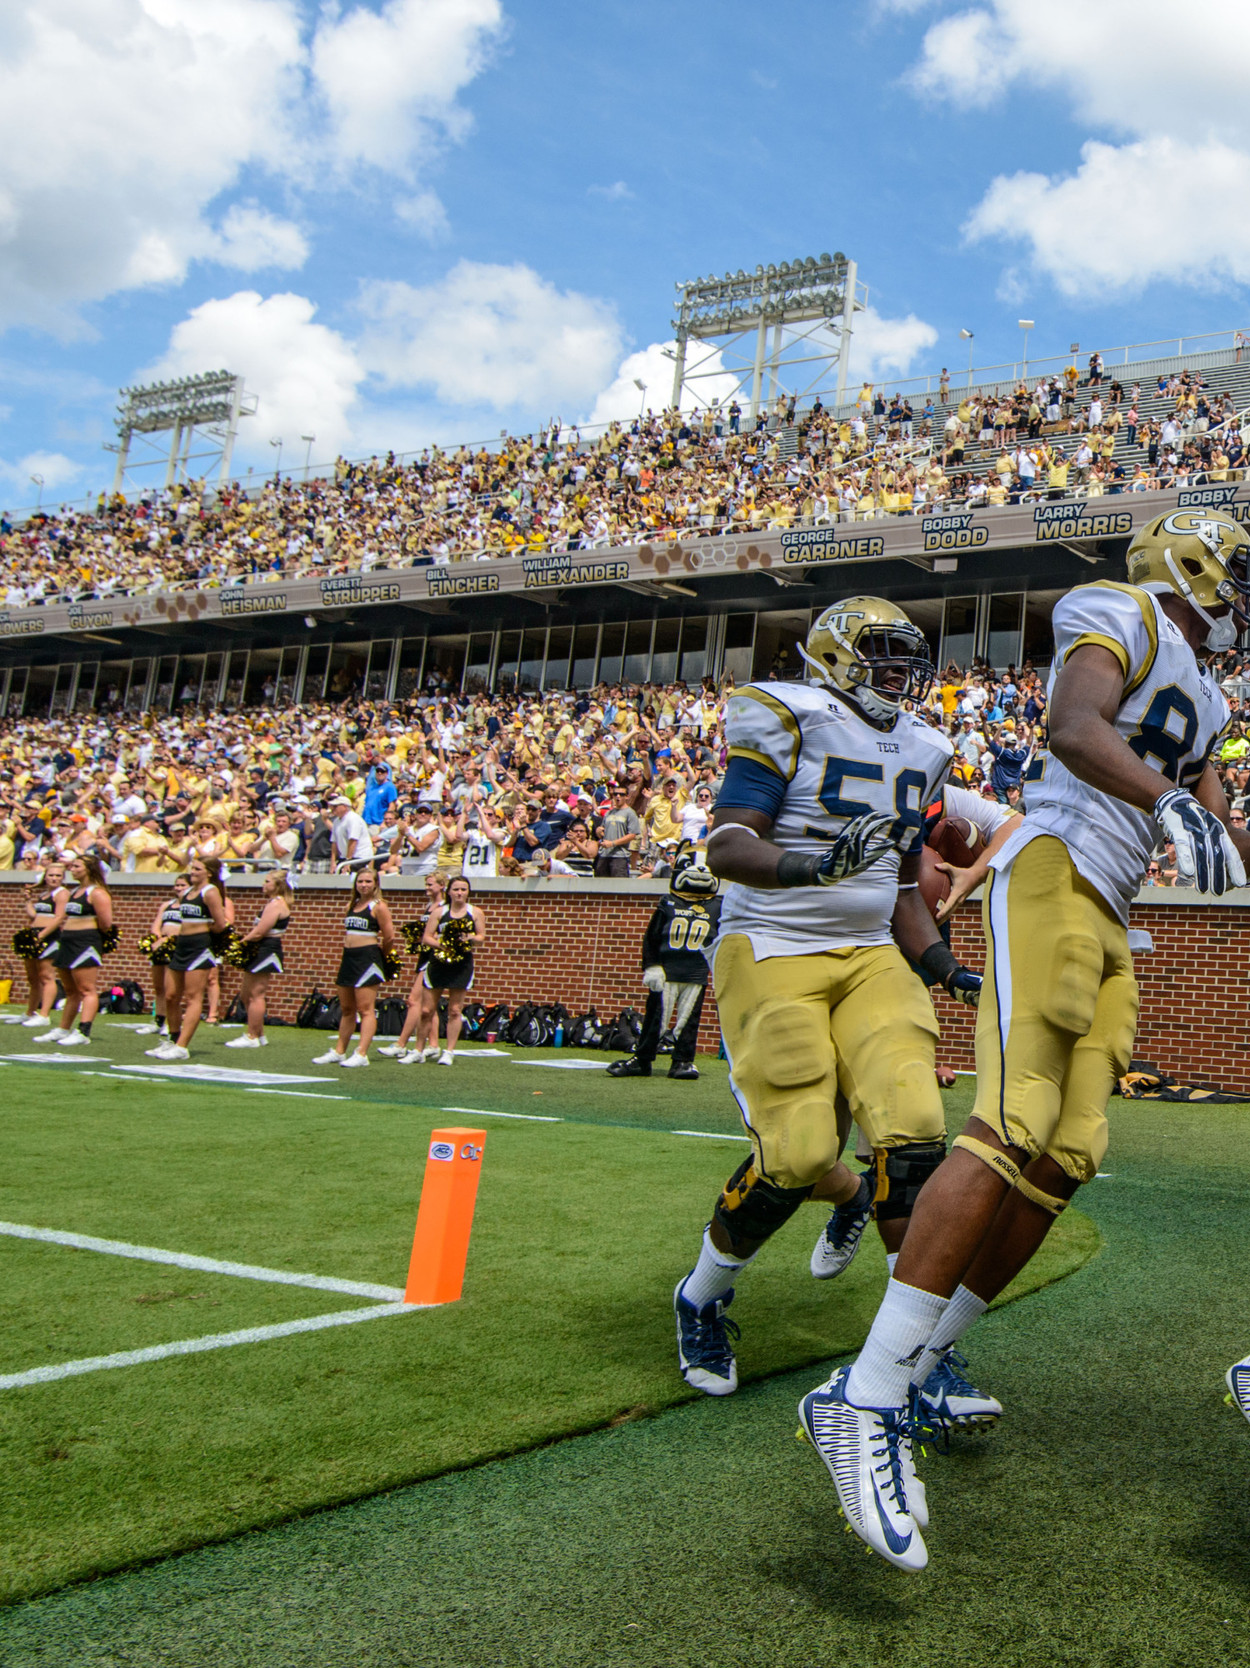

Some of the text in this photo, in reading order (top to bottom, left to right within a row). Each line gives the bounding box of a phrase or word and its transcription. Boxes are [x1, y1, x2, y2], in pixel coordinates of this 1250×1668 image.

[1178, 487, 1238, 507] BOBBY
[1034, 502, 1087, 522] LARRY
[922, 514, 973, 532] BOBBY
[1036, 513, 1132, 540] MORRIS
[781, 529, 834, 546] GEORGE
[925, 527, 988, 550] DODD
[784, 537, 884, 563] GARDNER
[523, 556, 571, 571] WILLIAM
[320, 577, 362, 591] EVERETT
[426, 569, 447, 580] BILL
[525, 562, 629, 587] ALEXANDER
[220, 589, 244, 600] JOHN
[322, 584, 400, 606] STRUPPER
[428, 575, 499, 596] FINCHER
[68, 605, 82, 616] JOE
[222, 596, 286, 615] HEISMAN
[70, 612, 112, 629] GUYON
[1199, 679, 1212, 703] TECH
[876, 742, 899, 753] TECH
[803, 753, 928, 858] 58
[469, 845, 489, 866] 21
[669, 917, 710, 951] 00
[992, 1155, 1018, 1178] RUSSELL
